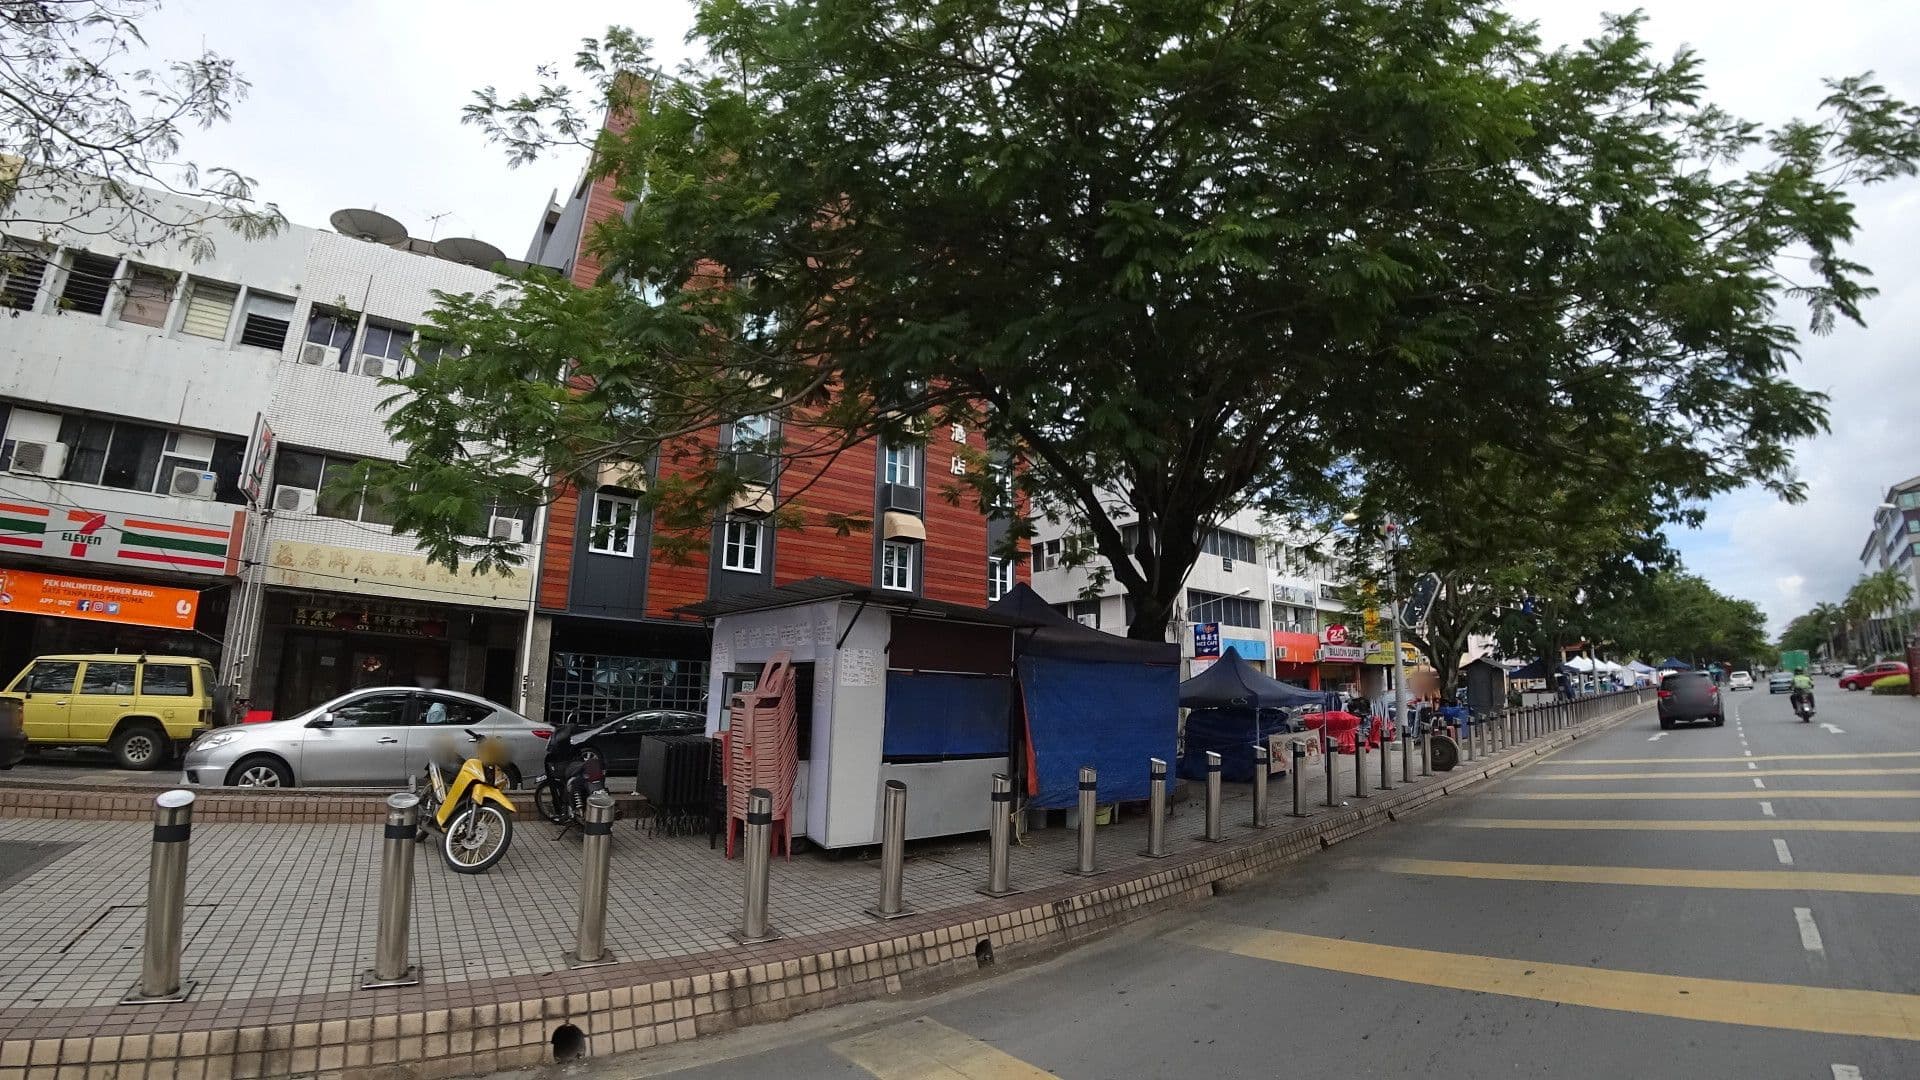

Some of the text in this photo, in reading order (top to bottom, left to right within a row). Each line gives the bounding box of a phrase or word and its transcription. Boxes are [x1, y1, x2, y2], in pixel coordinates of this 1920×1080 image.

[950, 422, 966, 475] 酒店
[60, 581, 103, 592] UNLIMITED
[103, 586, 131, 595] POWER
